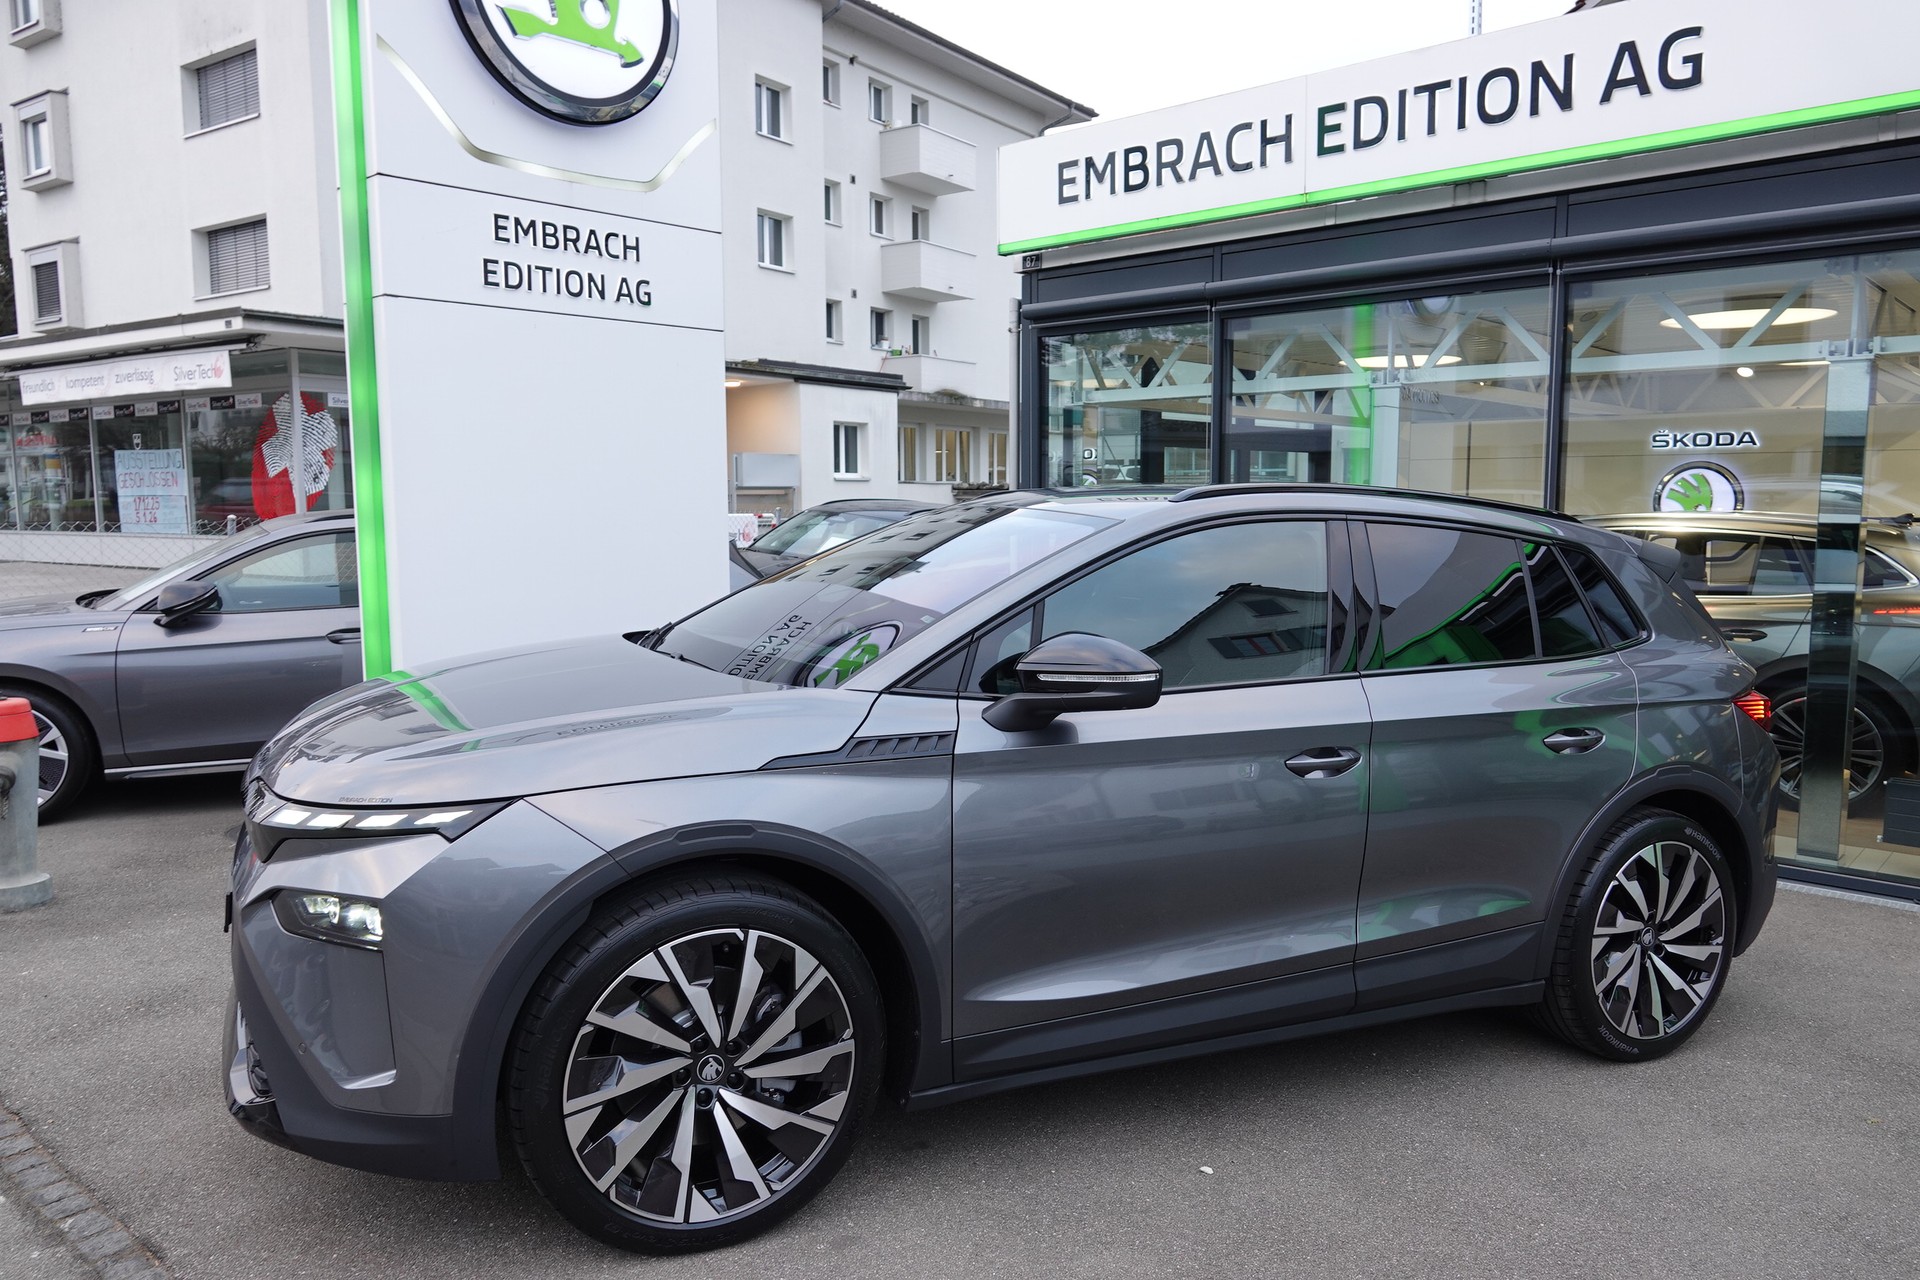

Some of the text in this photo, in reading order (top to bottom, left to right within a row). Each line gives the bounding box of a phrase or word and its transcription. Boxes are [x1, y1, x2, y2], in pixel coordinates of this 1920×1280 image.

[1057, 25, 1704, 206] EMBRACH EDITION AG
[493, 213, 641, 263] EMBRACH
[1026, 255, 1037, 267] 87
[482, 258, 652, 307] EDITION AG
[1651, 430, 1757, 447] ŠKODA
[116, 450, 182, 470] AUSSTELLUNG
